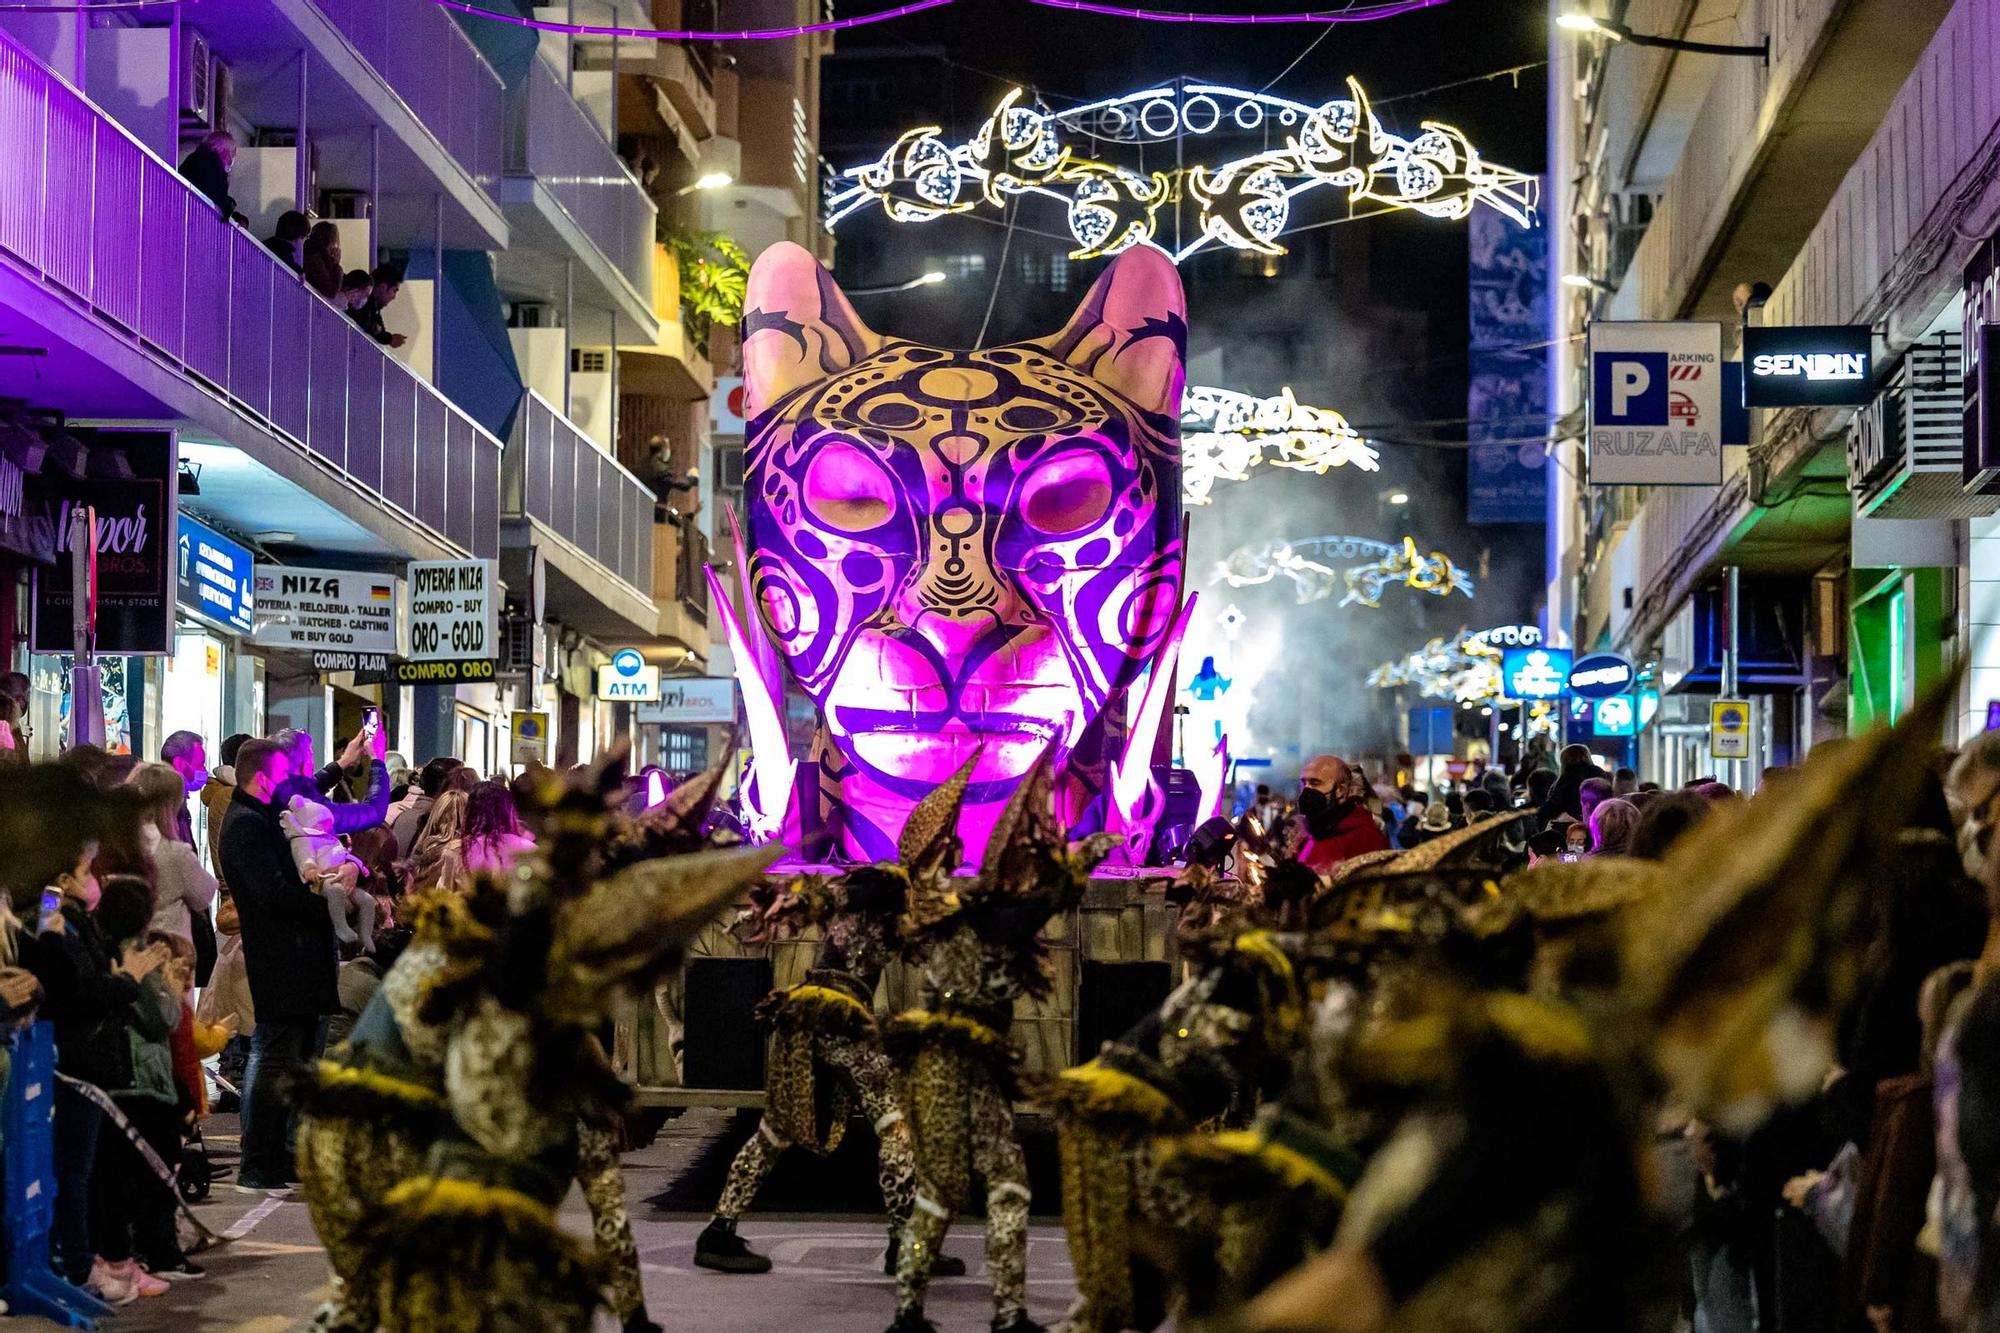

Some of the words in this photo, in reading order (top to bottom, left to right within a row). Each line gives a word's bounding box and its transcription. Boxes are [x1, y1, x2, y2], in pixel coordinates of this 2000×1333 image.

[1611, 361, 1649, 416] P
[1593, 431, 1716, 456] RUZAFA
[282, 575, 339, 598] NIZA
[414, 567, 455, 597] JOYERIA
[459, 567, 483, 592] NIZA
[128, 598, 159, 607] STORE
[300, 602, 350, 615] RELOJERIA
[357, 606, 391, 618] TALLER
[413, 601, 454, 614] COMPRO
[464, 600, 482, 613] BUY
[298, 616, 342, 629] WATCHES
[349, 620, 389, 632] CASTING
[290, 631, 305, 641] WE
[307, 632, 326, 642] BUY
[328, 634, 354, 644] GOLD
[412, 621, 439, 653] ORO
[452, 621, 484, 652] GOLD
[314, 652, 356, 669] COMPRO
[360, 655, 387, 671] PLATA
[399, 662, 457, 680] COMPRO
[462, 661, 493, 677] ORO
[609, 683, 648, 696] ATM
